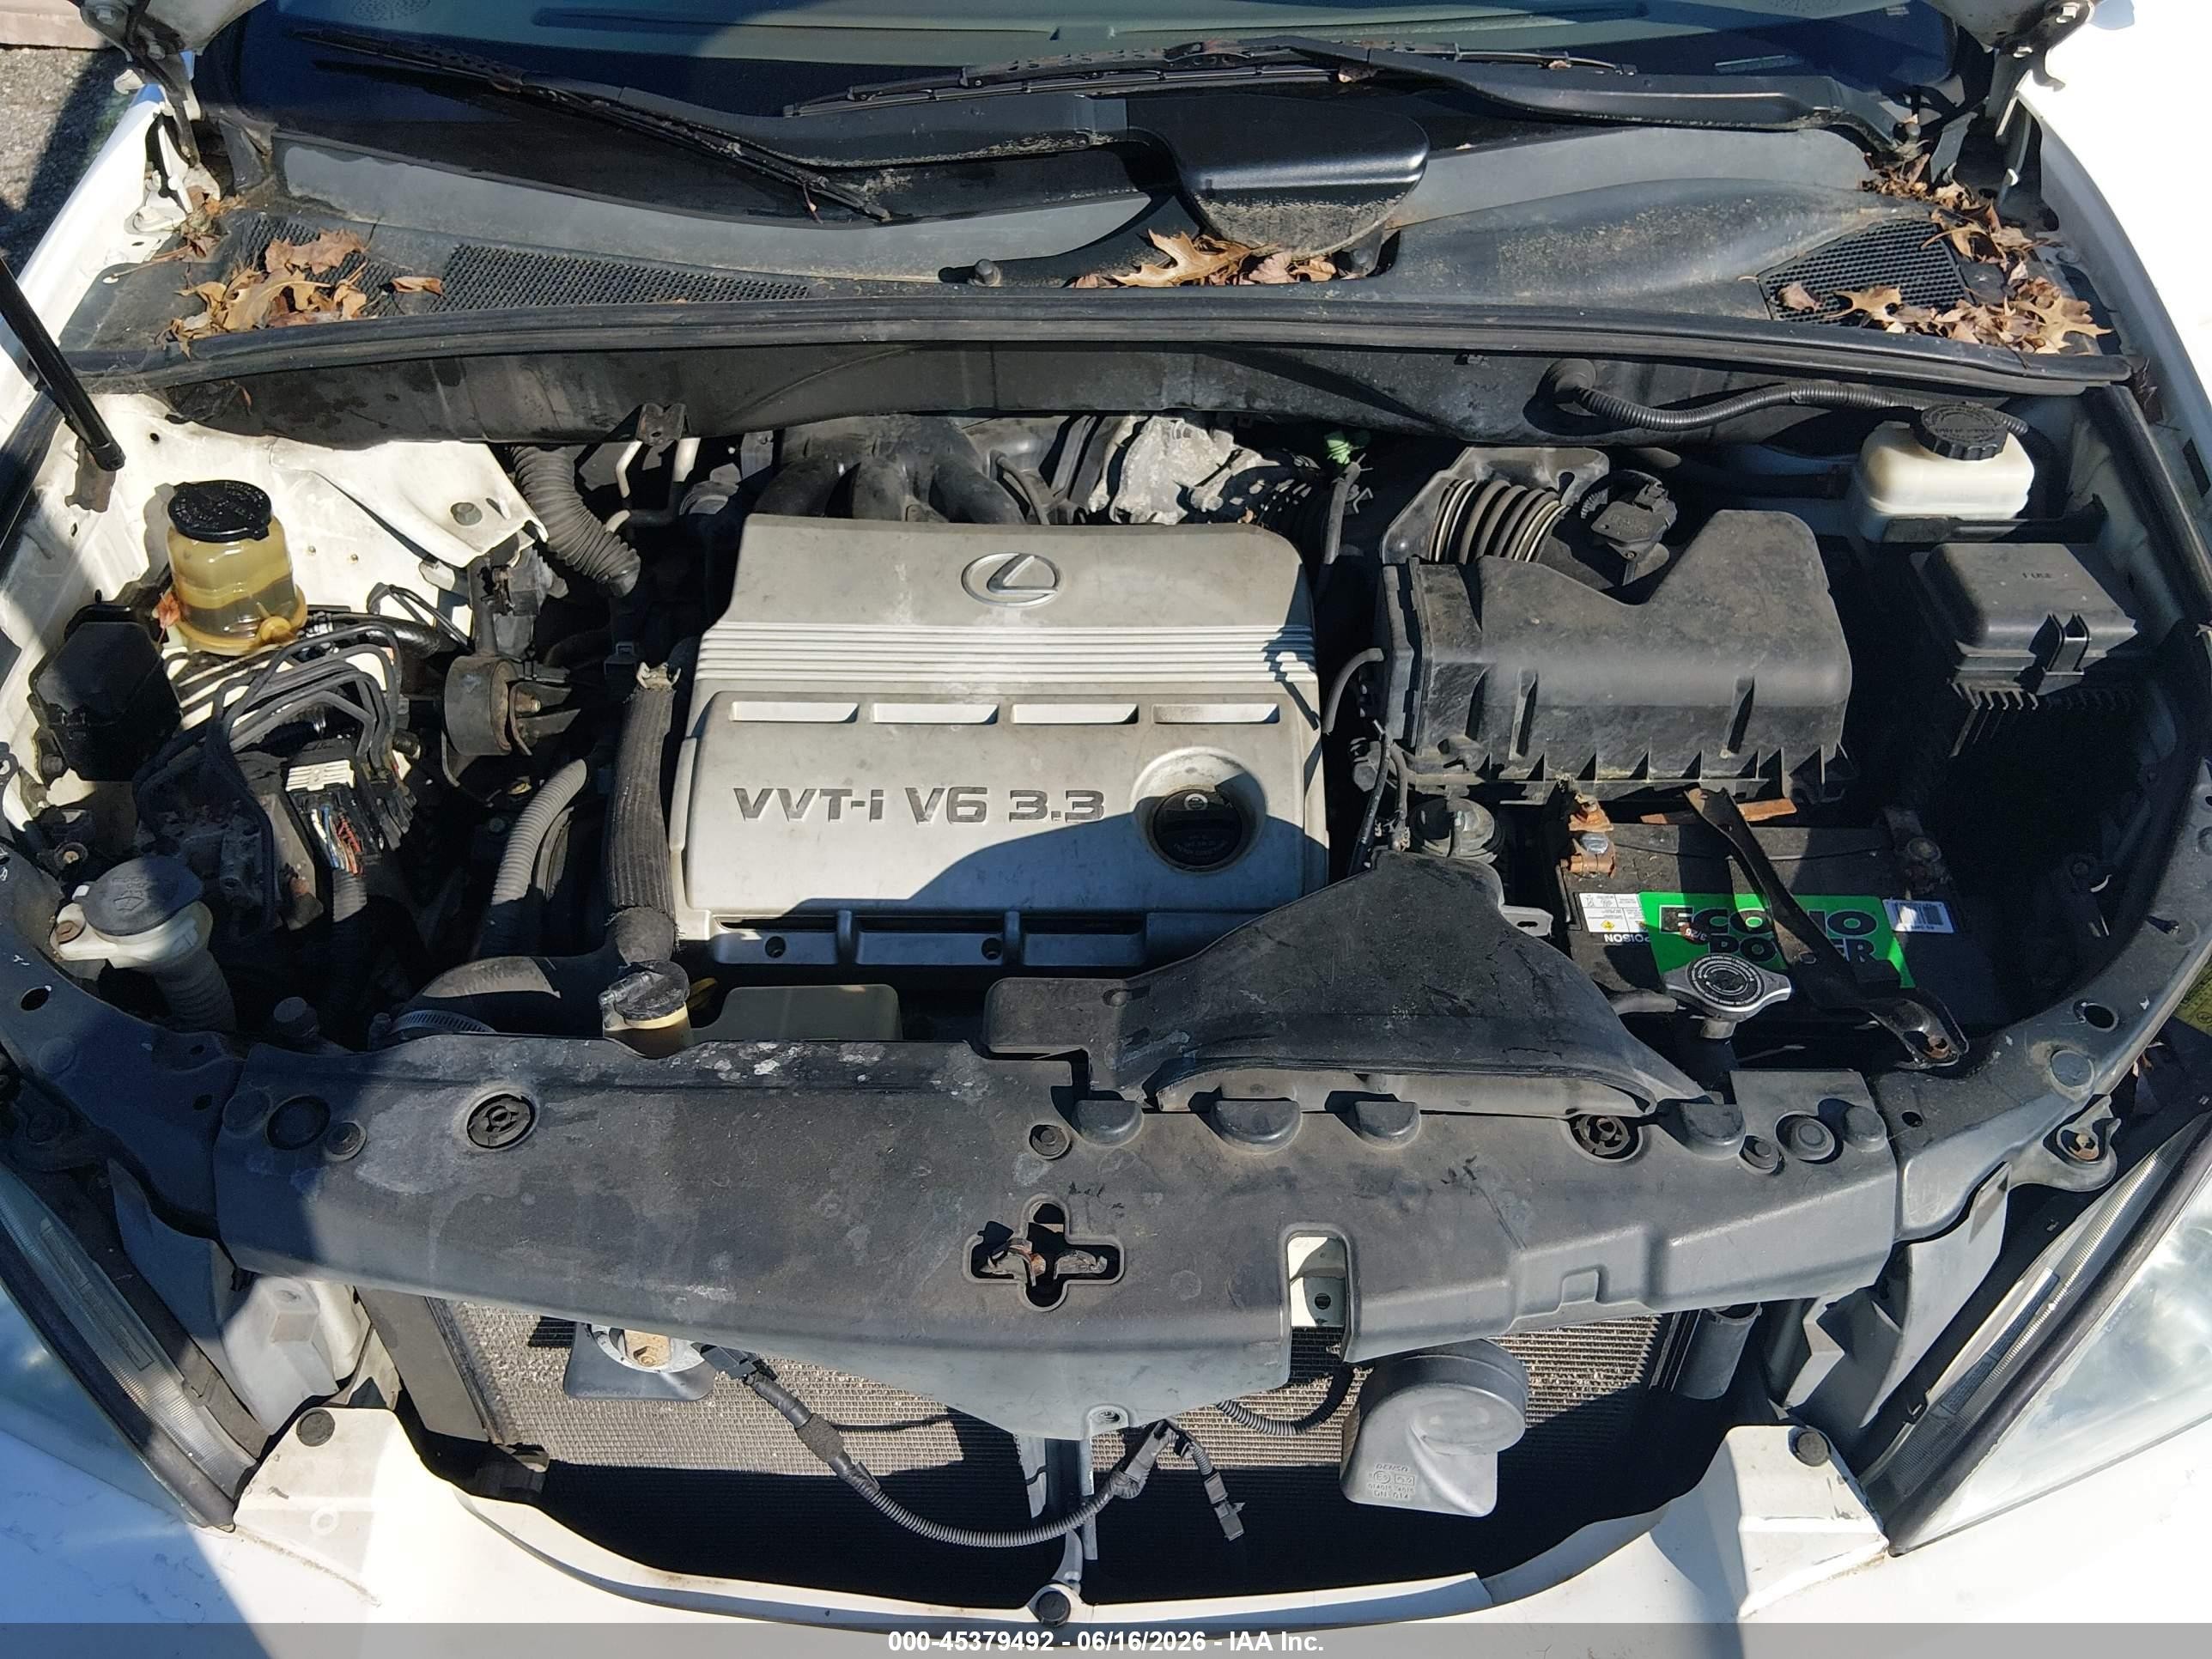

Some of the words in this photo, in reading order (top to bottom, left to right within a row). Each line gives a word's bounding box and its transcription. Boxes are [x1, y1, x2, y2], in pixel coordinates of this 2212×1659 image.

[732, 787, 884, 823] VVT-i
[905, 786, 989, 824] V6
[1008, 788, 1106, 823] 3.3
[1659, 904, 1878, 936] ECOO
